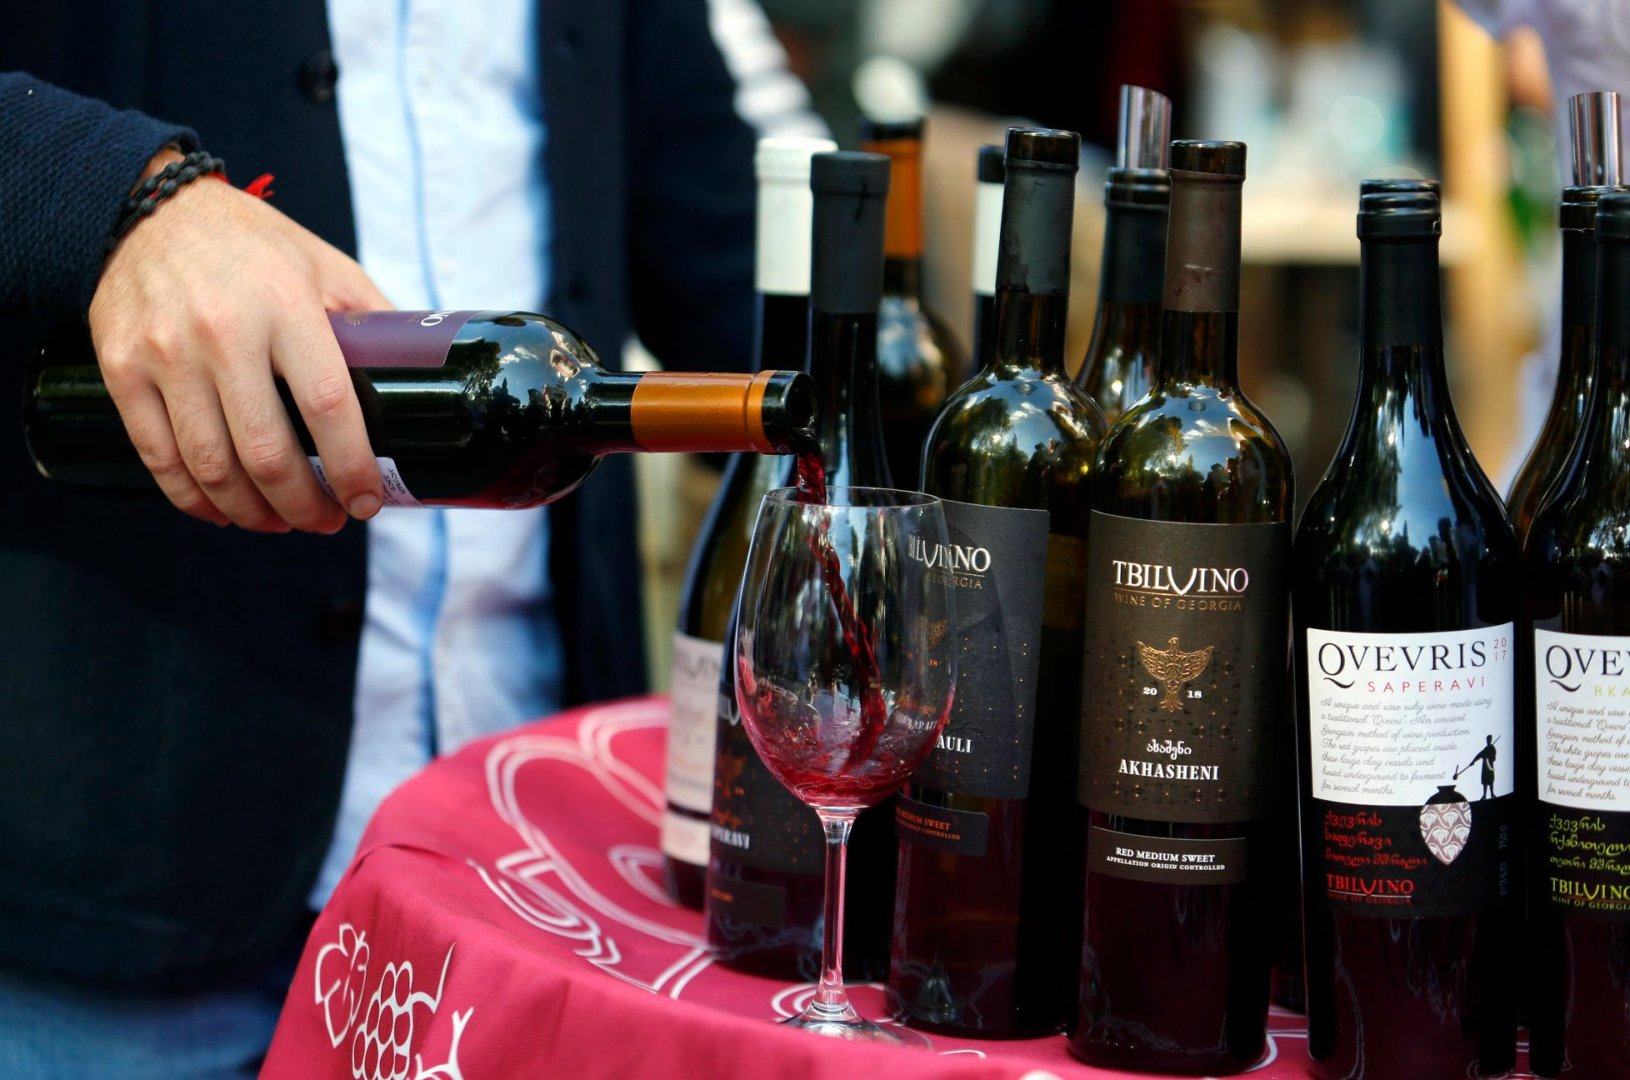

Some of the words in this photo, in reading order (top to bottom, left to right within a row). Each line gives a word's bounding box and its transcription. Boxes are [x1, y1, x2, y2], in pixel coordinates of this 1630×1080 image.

[1112, 559, 1249, 596] TBILVINO
[1114, 592, 1145, 606] WINE
[1152, 597, 1171, 609] OF
[1176, 599, 1242, 611] GEORGIA
[1318, 640, 1486, 689] QVEVRIS
[1545, 644, 1630, 693] QVE
[1142, 687, 1158, 697] 20
[1187, 690, 1203, 699] 18
[1368, 677, 1486, 694] SAPERAVI
[1333, 701, 1360, 714] unique
[1361, 702, 1381, 711] and
[1383, 703, 1402, 711] rare
[1404, 701, 1424, 716] ruby
[1426, 702, 1447, 710] wine
[1450, 698, 1472, 708] made
[1473, 697, 1493, 710] using
[1558, 706, 1585, 718] unique
[1586, 706, 1606, 715] and
[1327, 712, 1369, 724] traditional
[1410, 714, 1432, 725] An
[1434, 713, 1467, 724] ancient
[1552, 717, 1593, 729] traditional
[1321, 723, 1355, 741] Georgian
[1358, 727, 1390, 739] method
[1391, 728, 1403, 742] of
[1546, 727, 1579, 745] Georgian
[1582, 733, 1613, 745] method
[1615, 734, 1627, 748] of
[1322, 737, 1337, 749] The
[1338, 742, 1352, 751] red
[1352, 745, 1381, 756] grapes
[1398, 742, 1432, 756] placed
[1433, 741, 1458, 752] inside
[1547, 741, 1561, 752] The
[1563, 744, 1582, 755] white
[1583, 750, 1611, 761] grapes
[1118, 758, 1219, 781] AKHASHENI
[1322, 752, 1338, 763] these
[1340, 753, 1361, 770] large
[1362, 755, 1382, 771] clay
[1384, 757, 1413, 767] vessels
[1415, 757, 1435, 767] and
[1547, 755, 1562, 766] these
[1565, 758, 1585, 774] large
[1587, 763, 1606, 776] clay
[1322, 765, 1342, 777] buried
[1343, 769, 1398, 785] underground
[1399, 772, 1409, 781] to
[1409, 770, 1446, 784] ferment
[1547, 768, 1567, 781] buried
[1567, 774, 1622, 790] underground
[1321, 778, 1331, 792] for
[1333, 783, 1360, 793] several
[1546, 782, 1556, 795] for
[1558, 787, 1584, 797] several
[1106, 855, 1149, 867] APPELLATION
[1150, 862, 1177, 870] ORIGIN
[1115, 847, 1134, 858] RED
[1136, 850, 1179, 862] MEDIUM
[1181, 854, 1216, 863] SWEET
[1326, 874, 1414, 895] TBILVINO
[1574, 898, 1585, 907] OF
